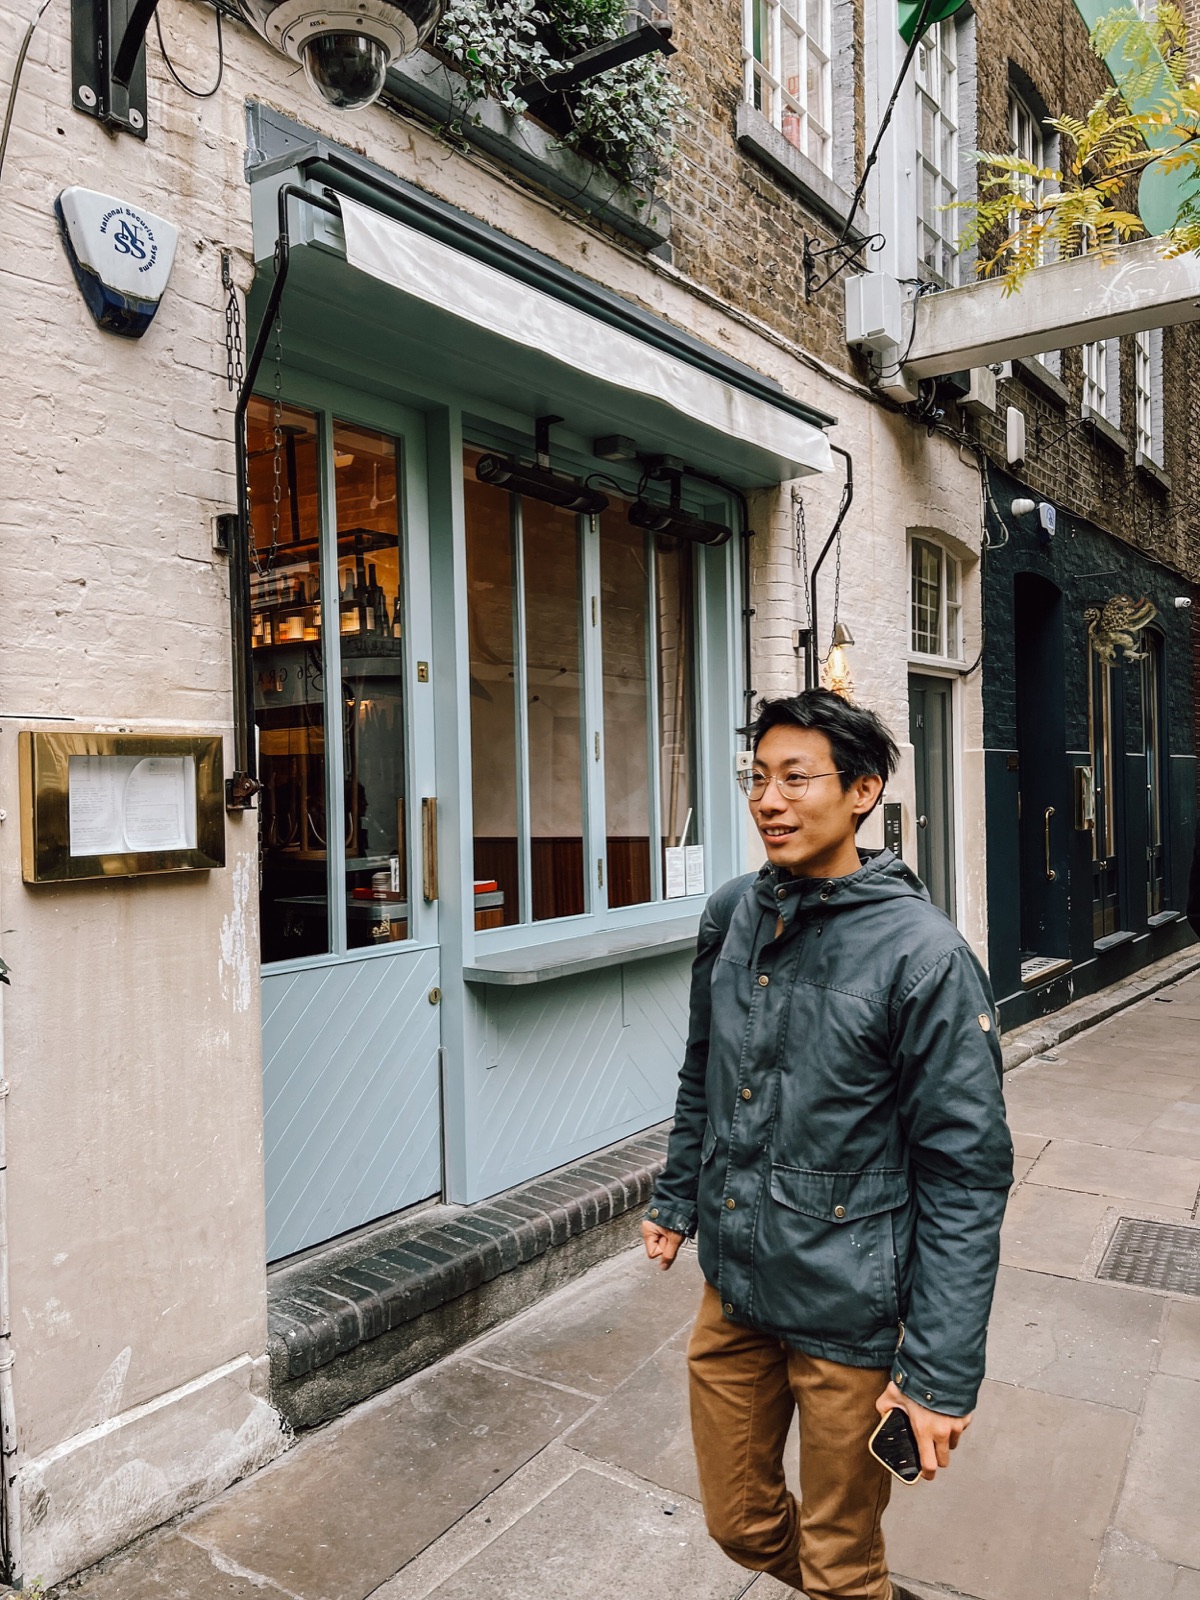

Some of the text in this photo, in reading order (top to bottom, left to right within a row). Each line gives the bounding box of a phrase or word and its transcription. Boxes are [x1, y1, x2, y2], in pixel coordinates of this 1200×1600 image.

[100, 207, 158, 273] National Security Systems
